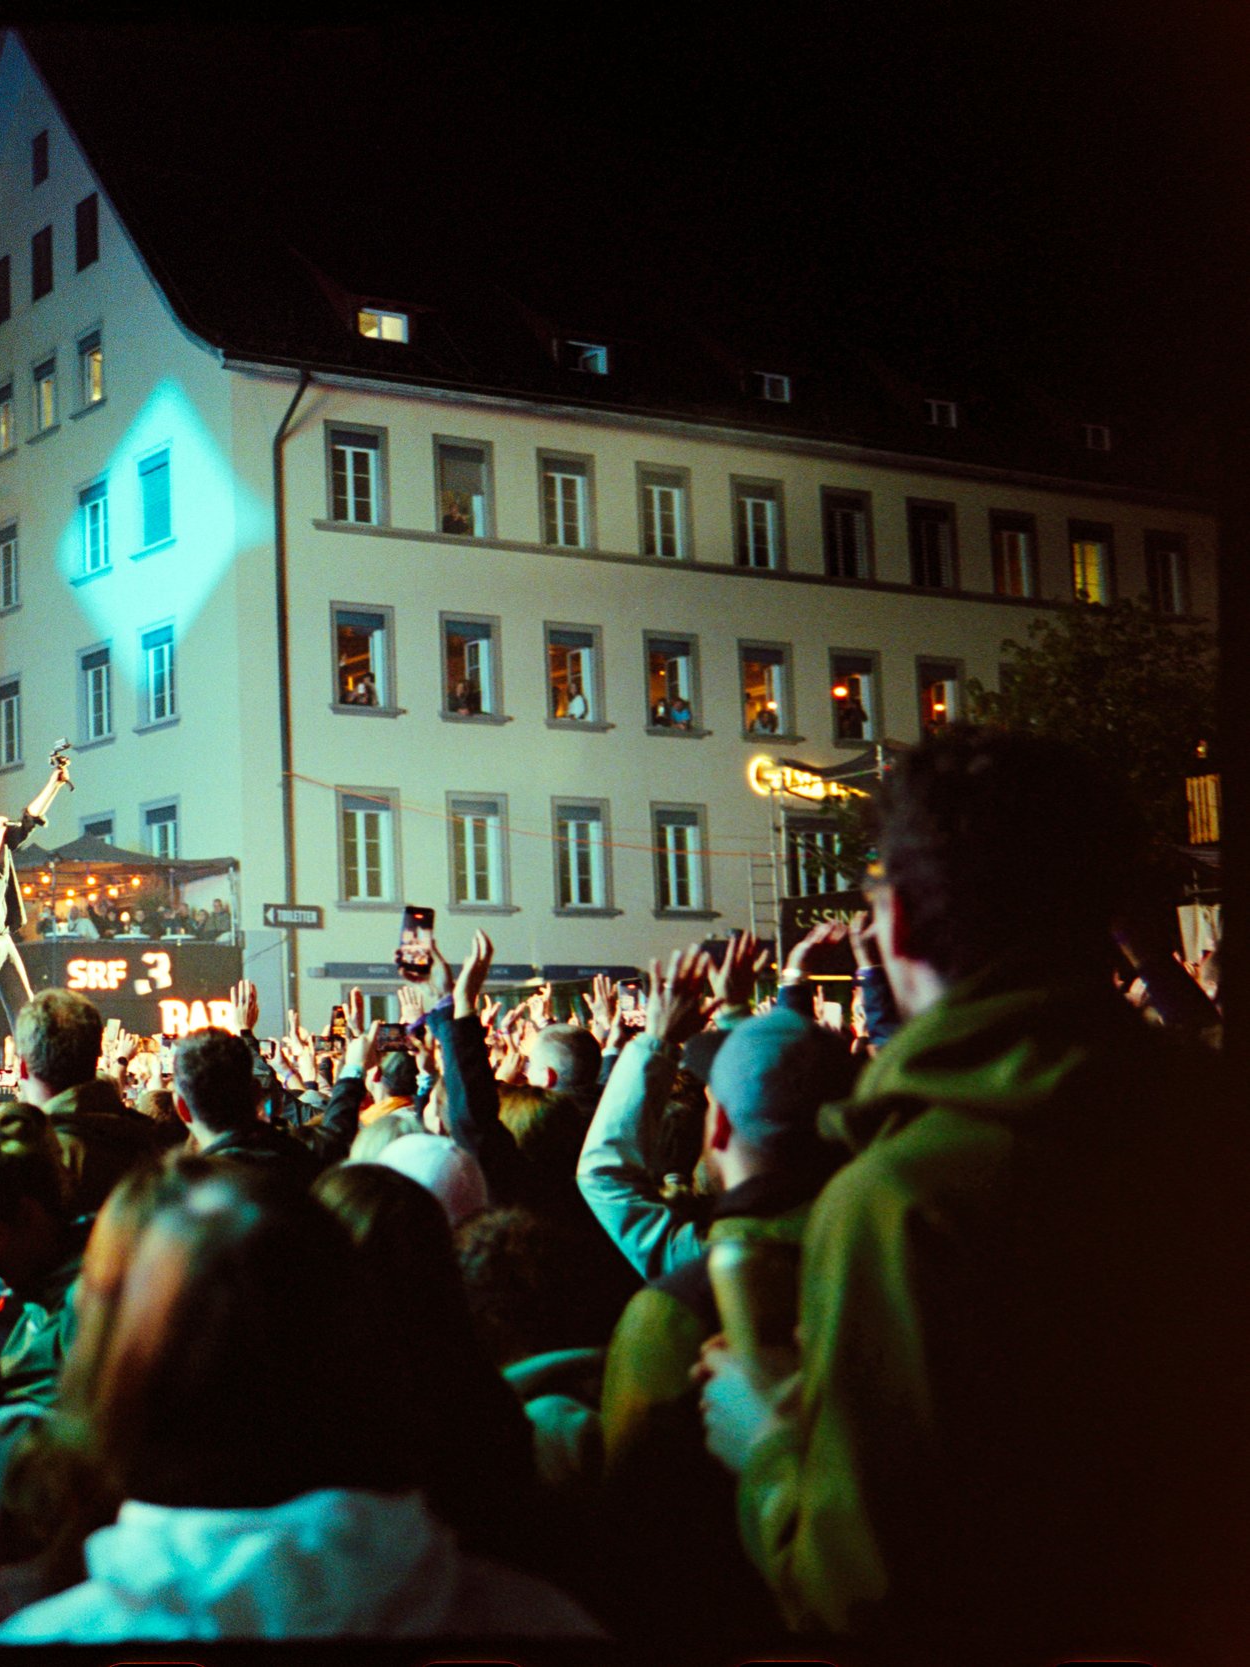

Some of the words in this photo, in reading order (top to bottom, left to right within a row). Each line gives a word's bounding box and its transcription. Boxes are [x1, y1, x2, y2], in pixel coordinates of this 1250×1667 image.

[66, 958, 128, 991] SRF
[134, 951, 173, 996] 3
[158, 999, 237, 1037] BAR
